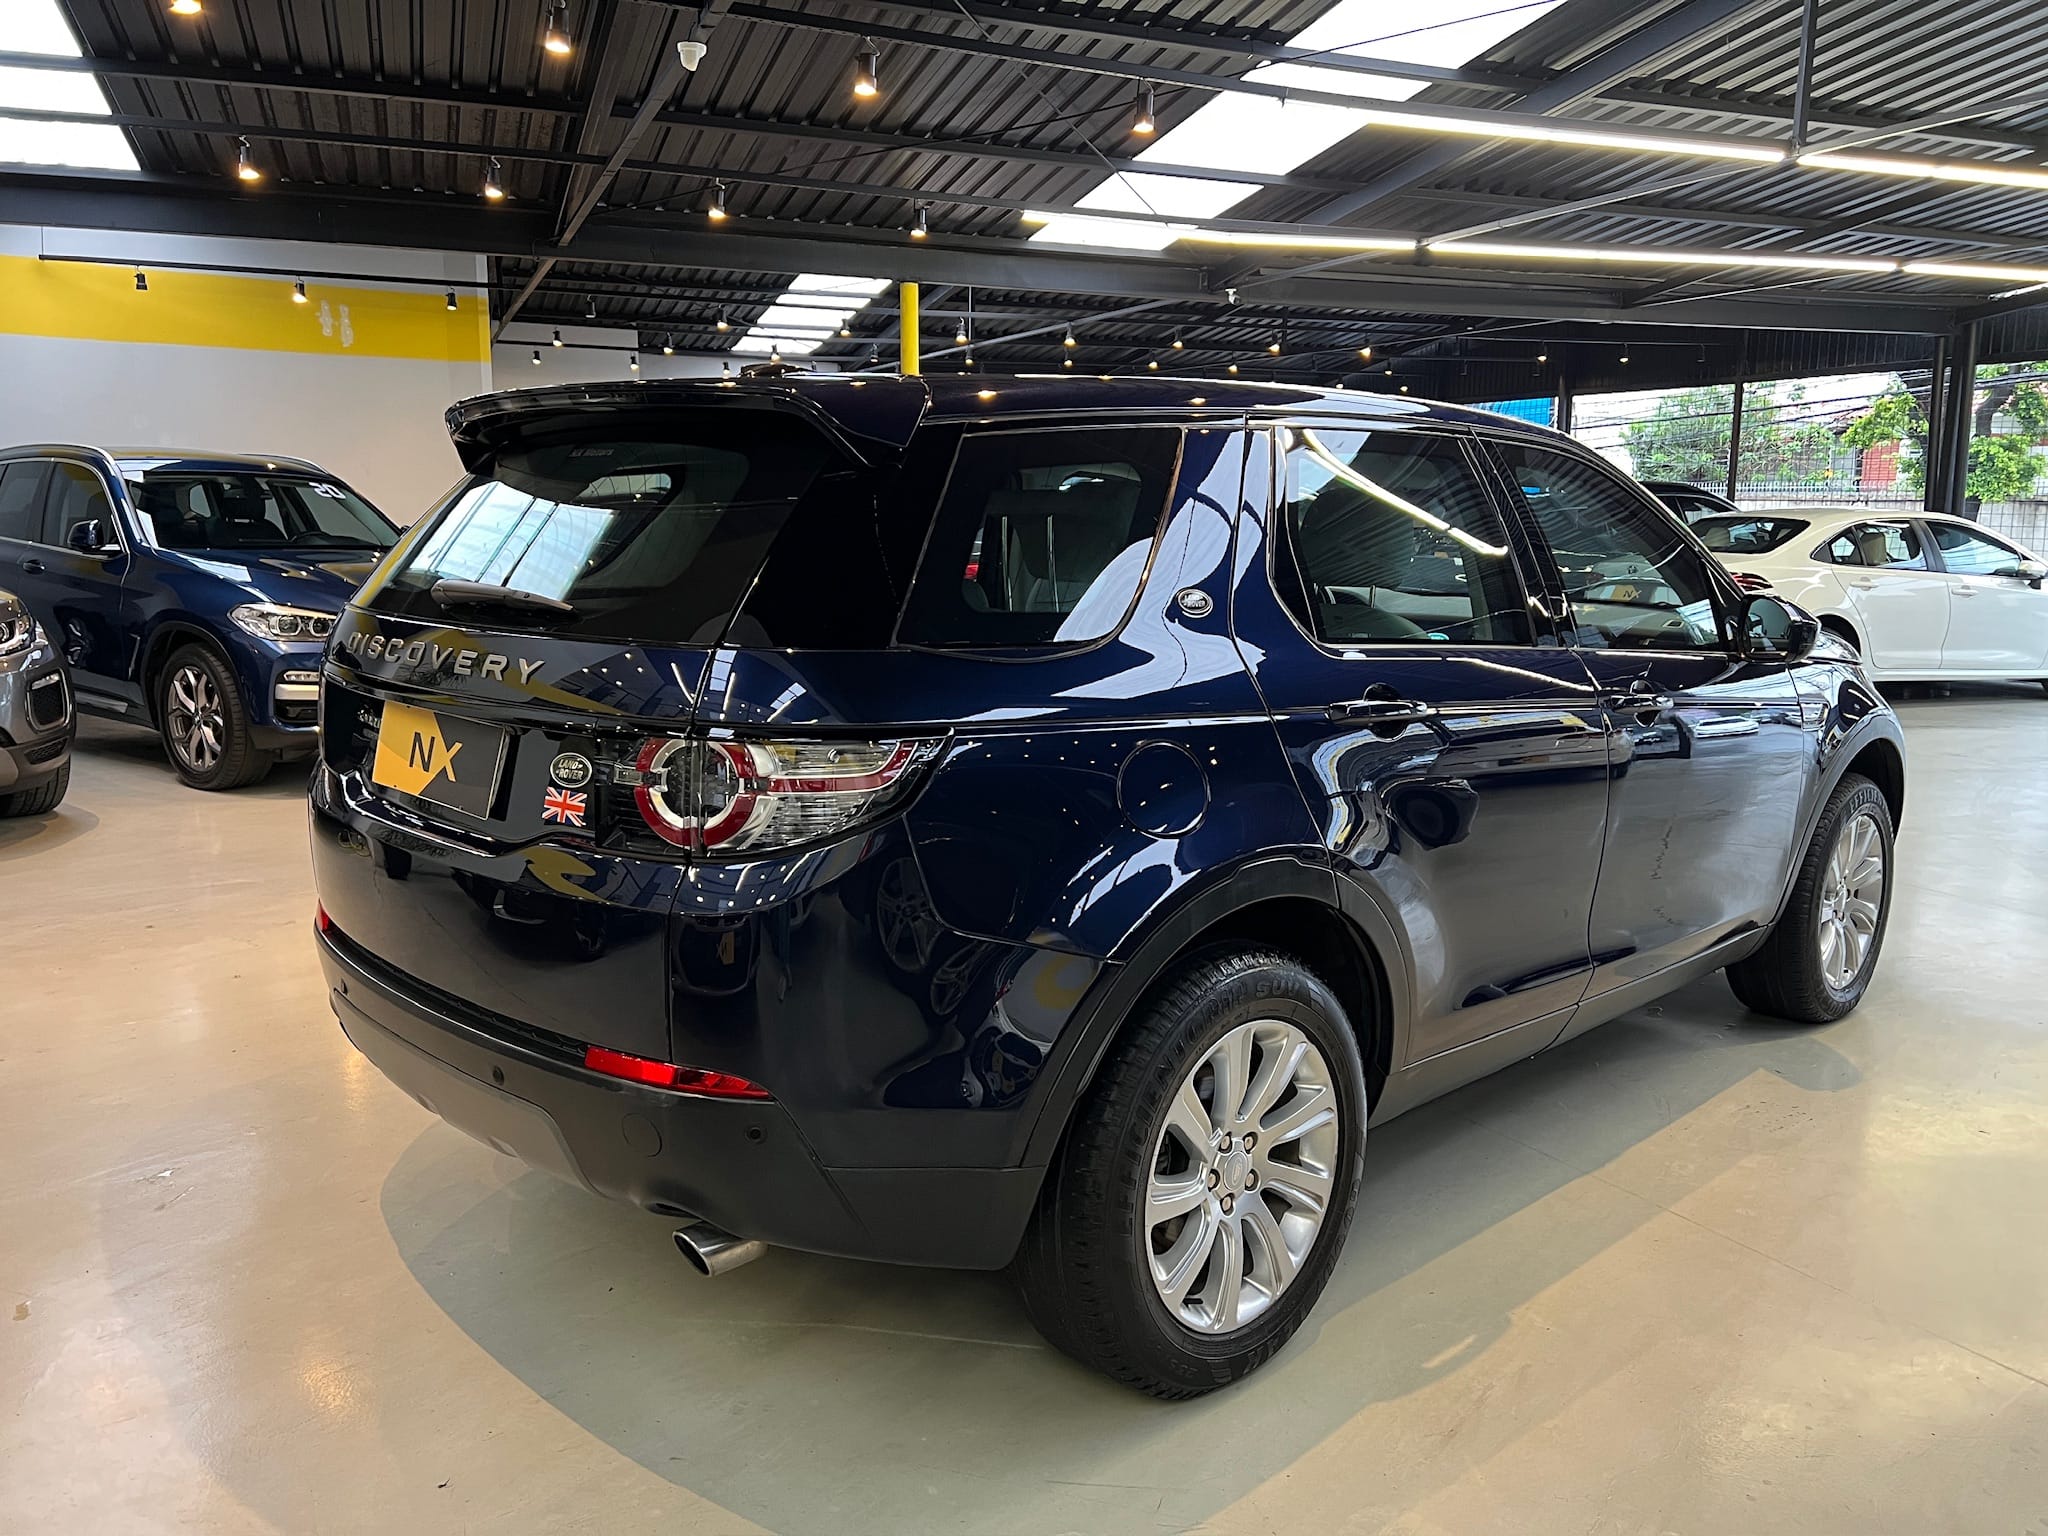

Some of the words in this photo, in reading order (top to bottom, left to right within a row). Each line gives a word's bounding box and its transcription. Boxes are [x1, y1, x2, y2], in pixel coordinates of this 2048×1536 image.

[346, 631, 545, 684] DISCOVERY
[409, 732, 464, 782] NX
[558, 759, 580, 769] LAND
[558, 769, 584, 780] ROVER
